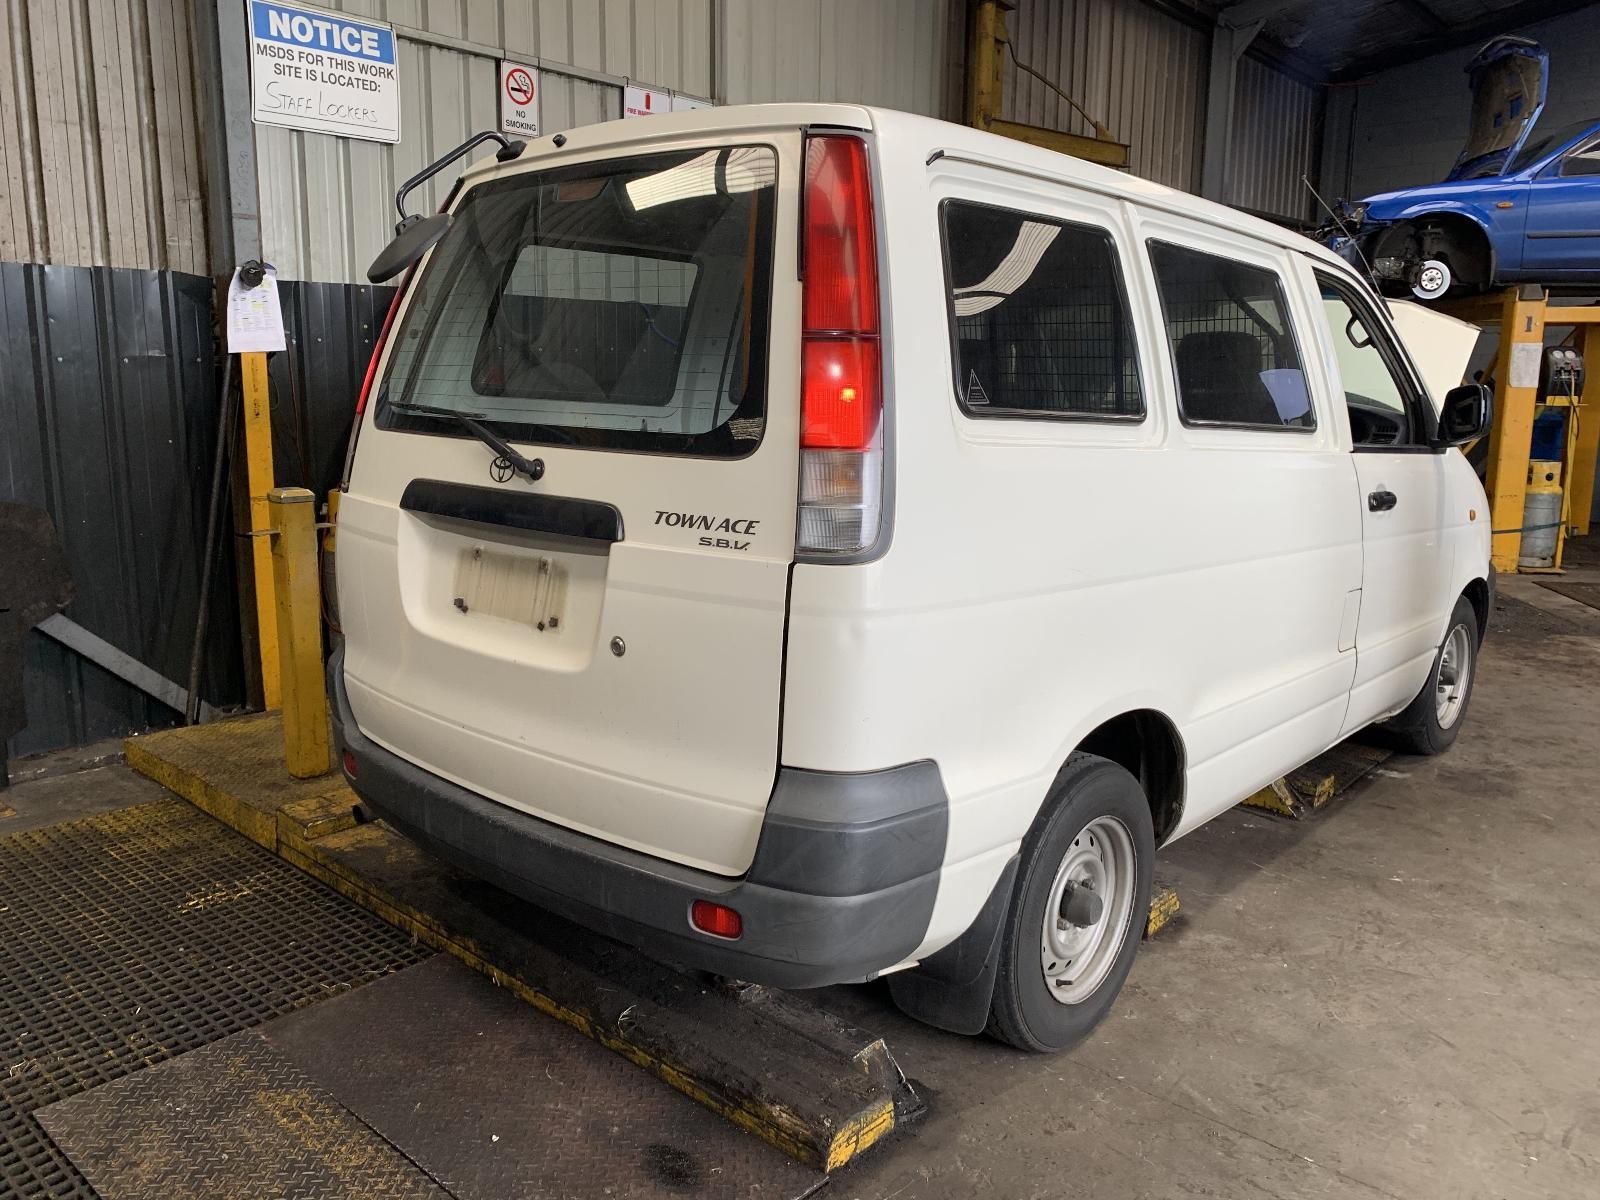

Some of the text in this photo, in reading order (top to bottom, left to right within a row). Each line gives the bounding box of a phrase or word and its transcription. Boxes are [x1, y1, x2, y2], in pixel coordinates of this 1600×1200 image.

[268, 10, 381, 57] NOTICE
[256, 43, 395, 80] MSDS FOR THIS WORK
[274, 63, 381, 93] SITE IS LOCATED:
[263, 81, 378, 122] STAFF LOCKERS
[516, 110, 526, 118] NO
[505, 119, 537, 131] SMOKING
[654, 510, 760, 535] TOWN ACE
[699, 536, 750, 551] S.B.V.
